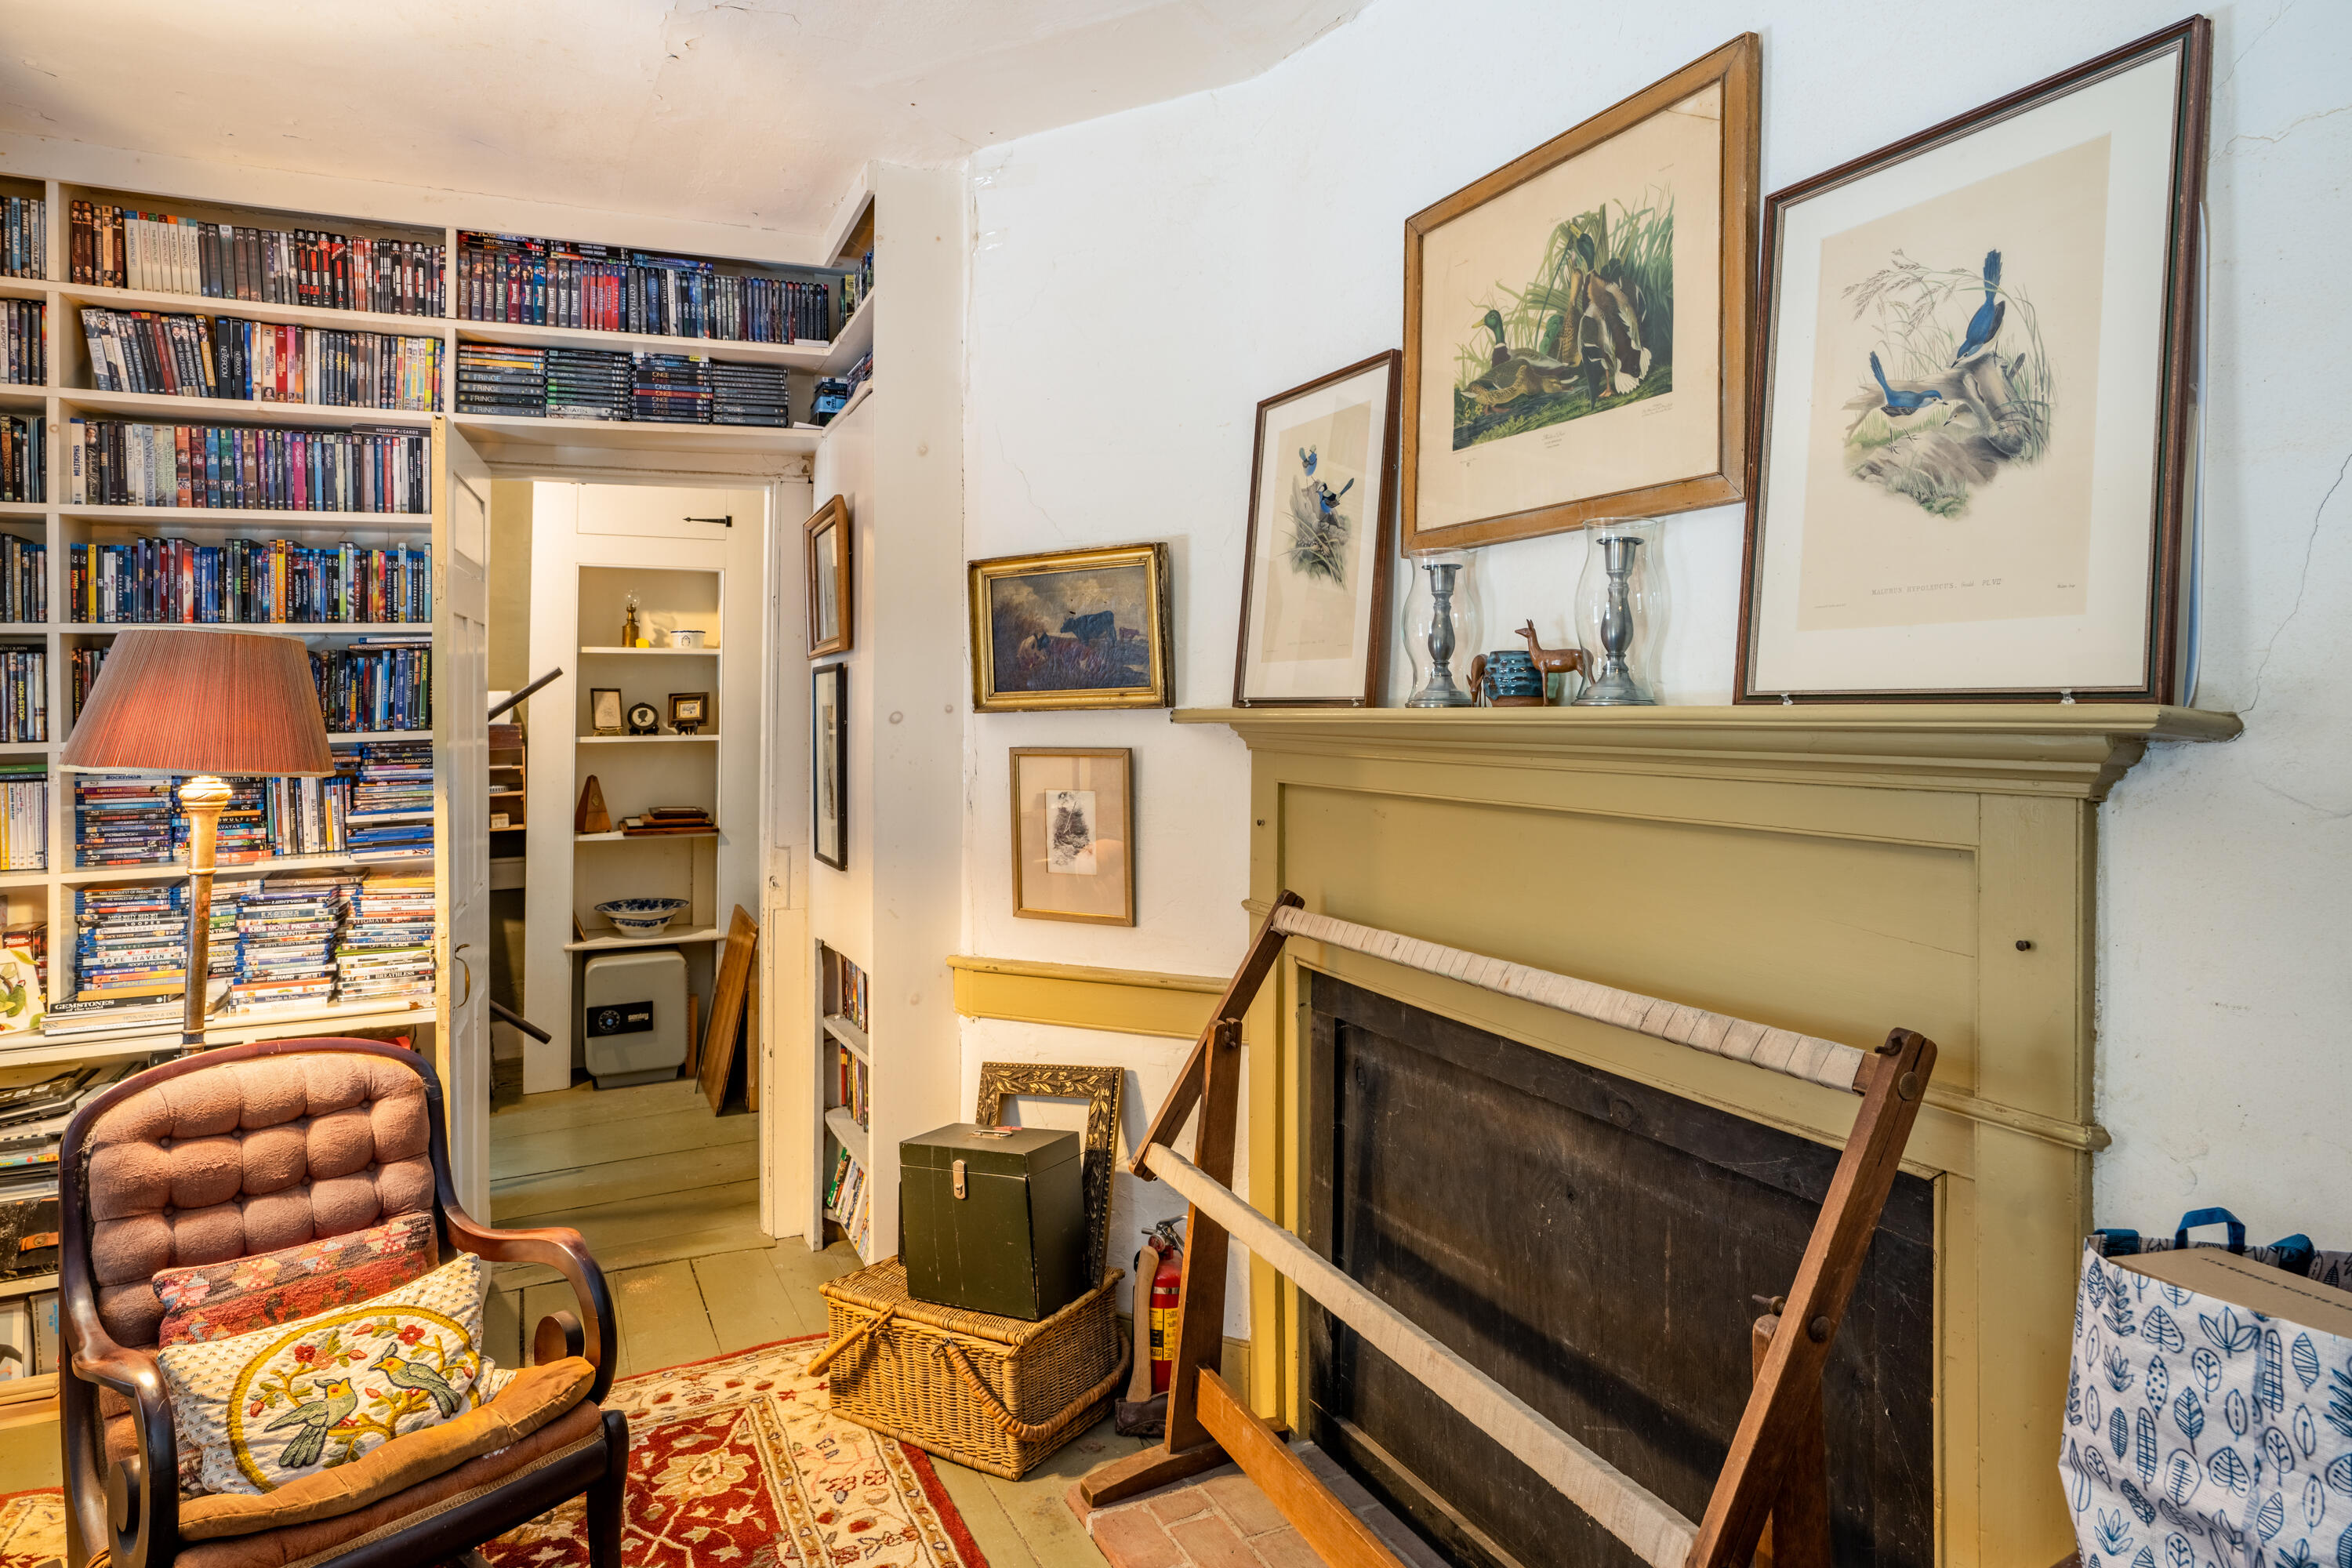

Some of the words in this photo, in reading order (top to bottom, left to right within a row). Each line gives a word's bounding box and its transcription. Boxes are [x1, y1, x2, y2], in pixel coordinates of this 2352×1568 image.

[122, 341, 134, 376] JAMESTOWN
[132, 342, 143, 377] JAMESTOWN
[179, 352, 188, 379] SELFRIDGE
[186, 352, 194, 379] SELFRIDGE
[195, 356, 204, 382] SELFRIDGE
[54, 1000, 114, 1010] GEMSTONES
[628, 1012, 649, 1021] sentry
